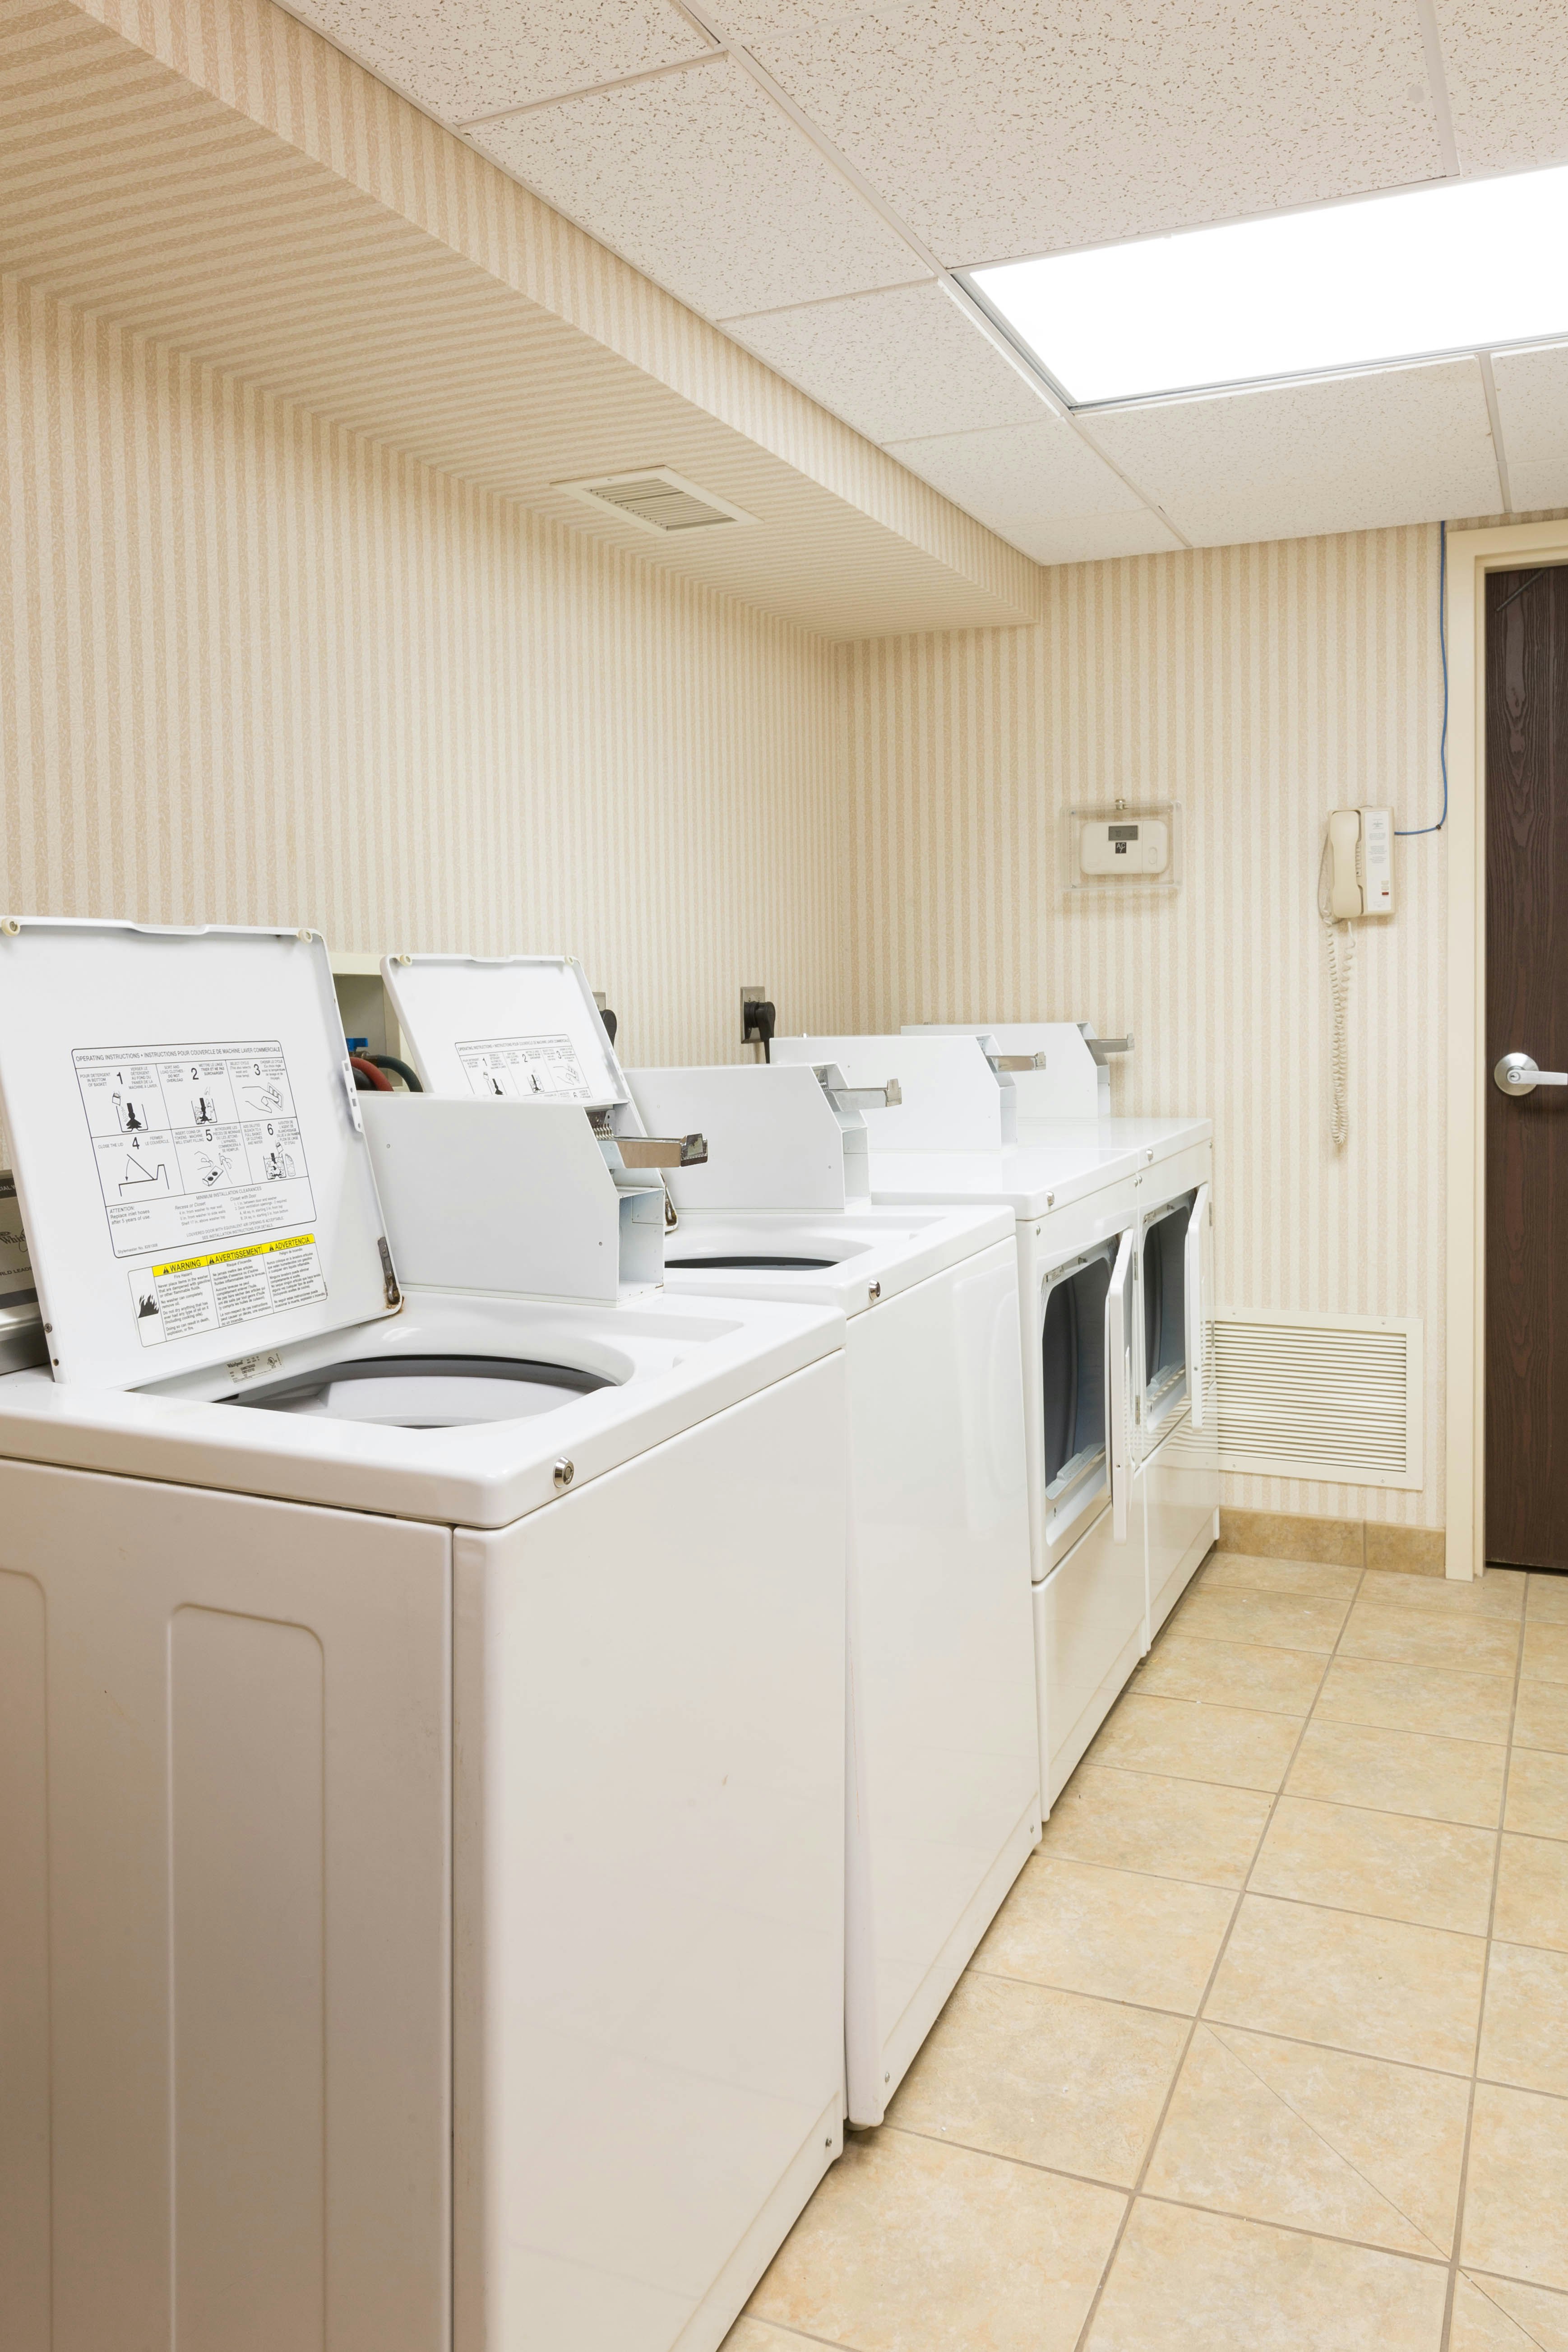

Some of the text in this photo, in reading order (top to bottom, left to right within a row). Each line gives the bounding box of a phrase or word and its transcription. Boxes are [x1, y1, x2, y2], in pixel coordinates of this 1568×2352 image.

[523, 1054, 528, 1062] 2
[556, 1051, 561, 1059] 3
[482, 1058, 487, 1066] 1
[191, 1068, 199, 1080] 2
[254, 1064, 260, 1075] 3
[117, 1072, 123, 1084] 1
[206, 1129, 213, 1141] 5
[267, 1123, 273, 1135] 6
[132, 1137, 140, 1149] 4
[275, 1236, 310, 1249] ADVERTENCIA
[216, 1247, 261, 1263] AVERTISSEMENT
[170, 1259, 201, 1272] WARNING
